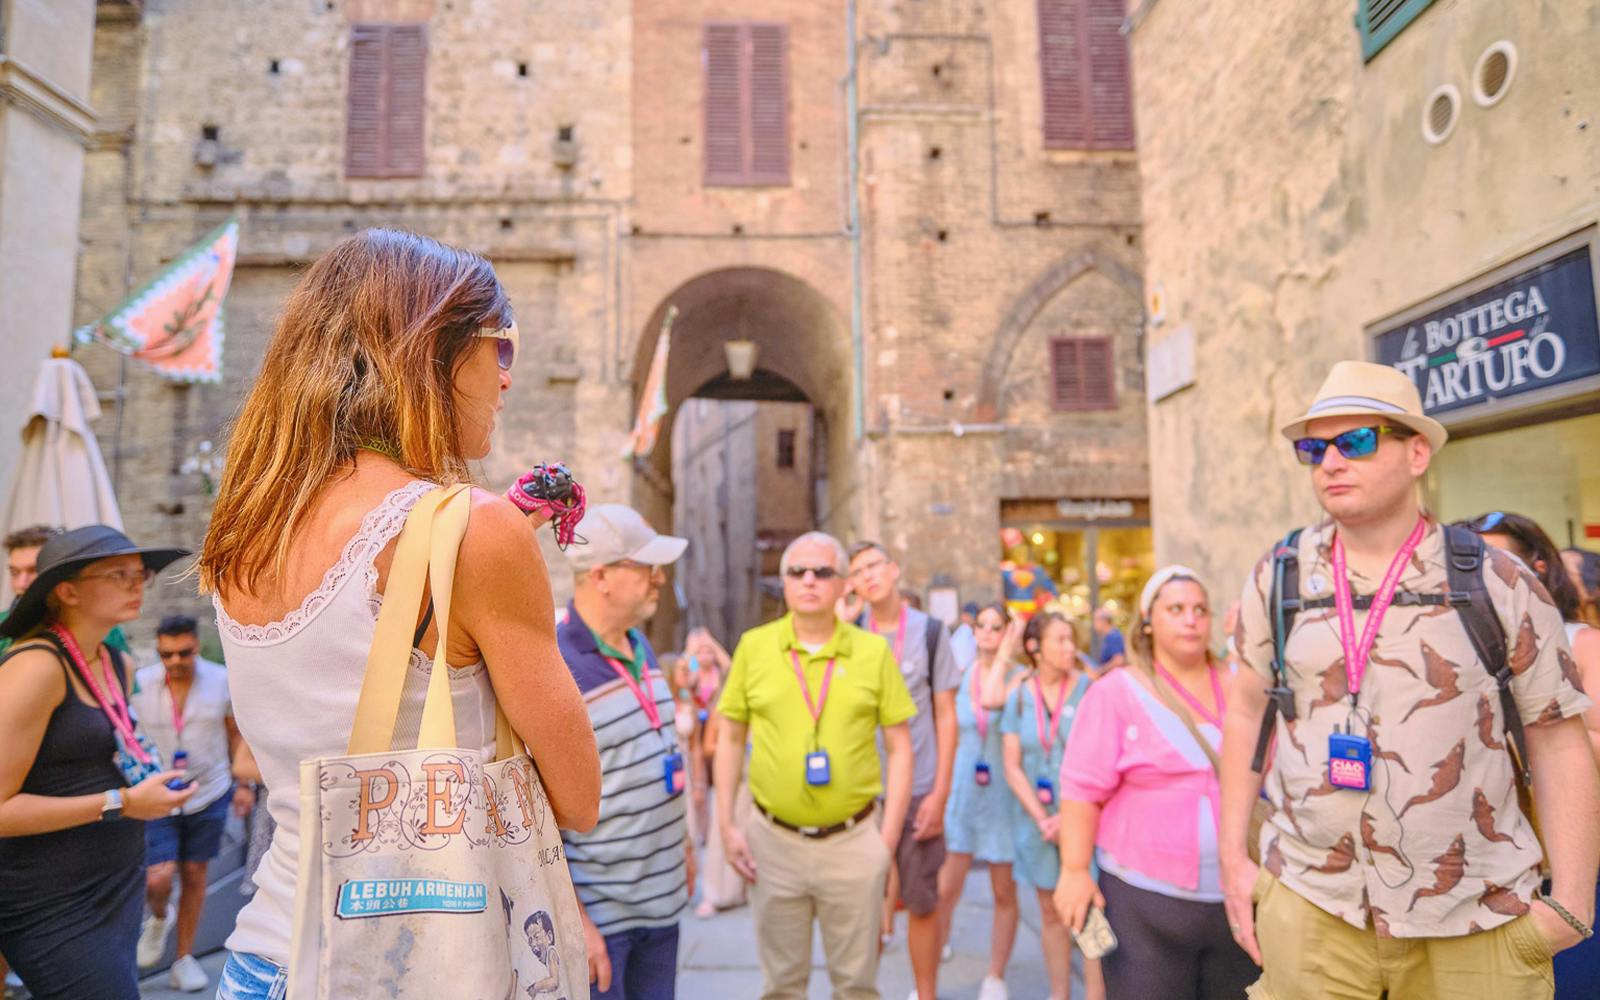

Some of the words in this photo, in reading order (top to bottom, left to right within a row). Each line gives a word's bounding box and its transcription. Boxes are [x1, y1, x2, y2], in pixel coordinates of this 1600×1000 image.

[1424, 286, 1549, 352] BOTTEGA
[1394, 332, 1566, 409] TARTUFO
[350, 881, 411, 899] LEBUH
[415, 881, 483, 898] ARMENIAN
